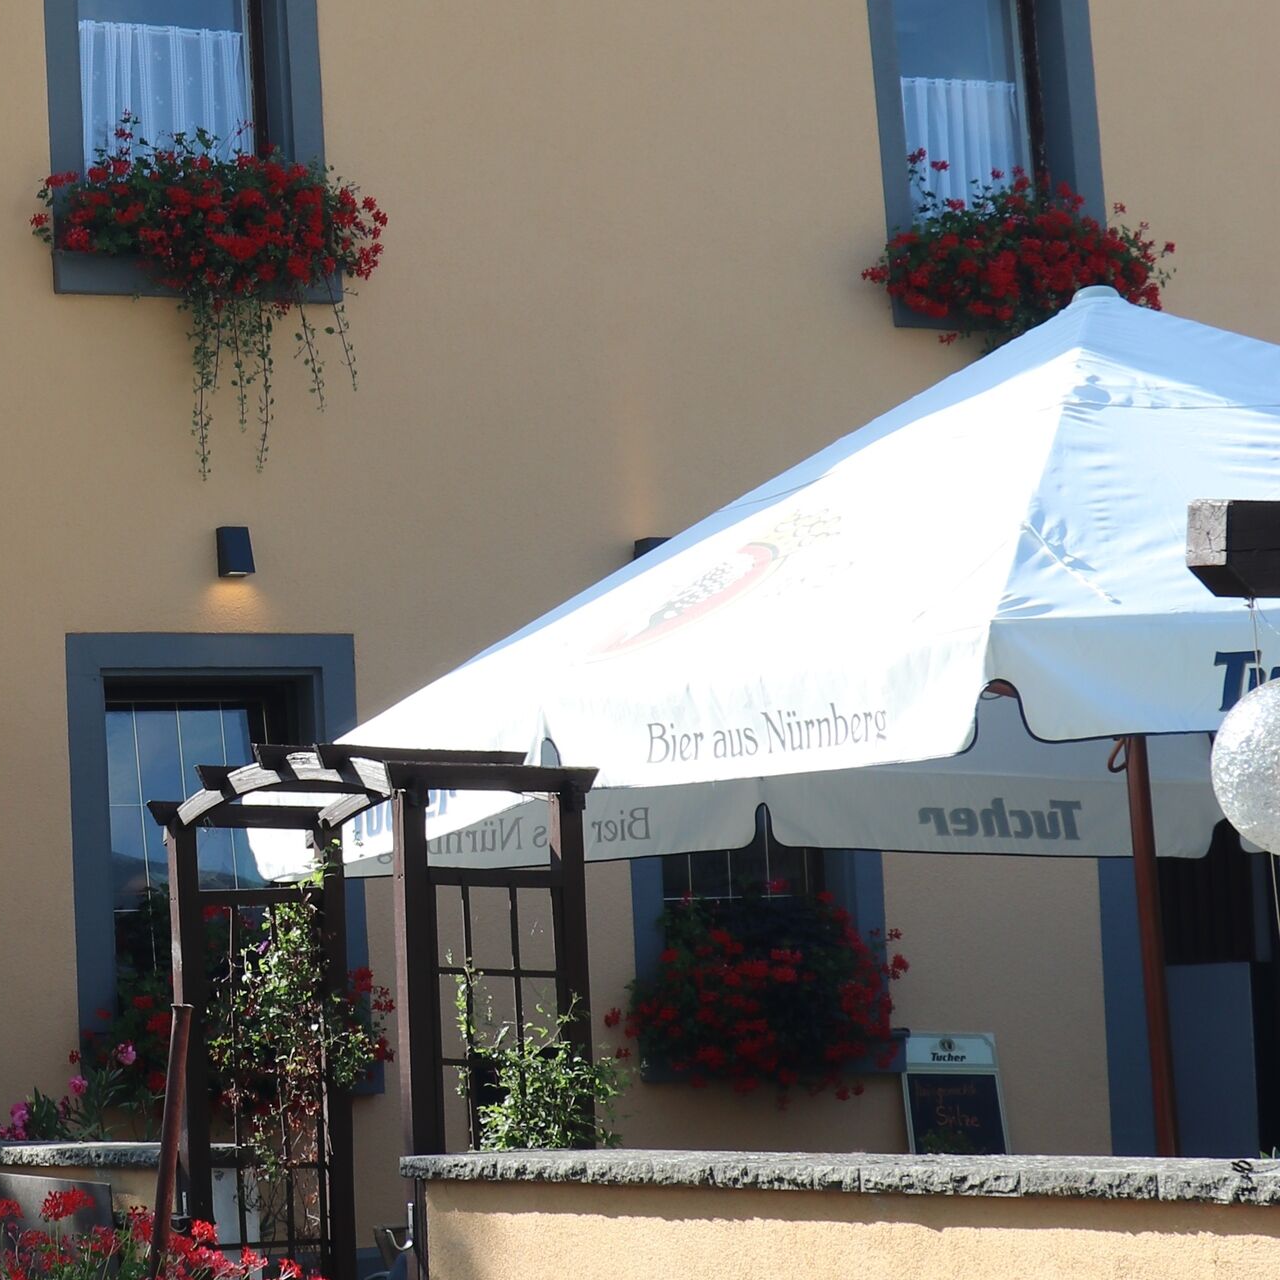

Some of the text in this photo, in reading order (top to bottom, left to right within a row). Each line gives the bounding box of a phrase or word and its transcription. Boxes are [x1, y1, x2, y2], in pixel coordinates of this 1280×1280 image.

[646, 702, 888, 764] Bier aus Nürnberg
[930, 1051, 967, 1063] Tucher
